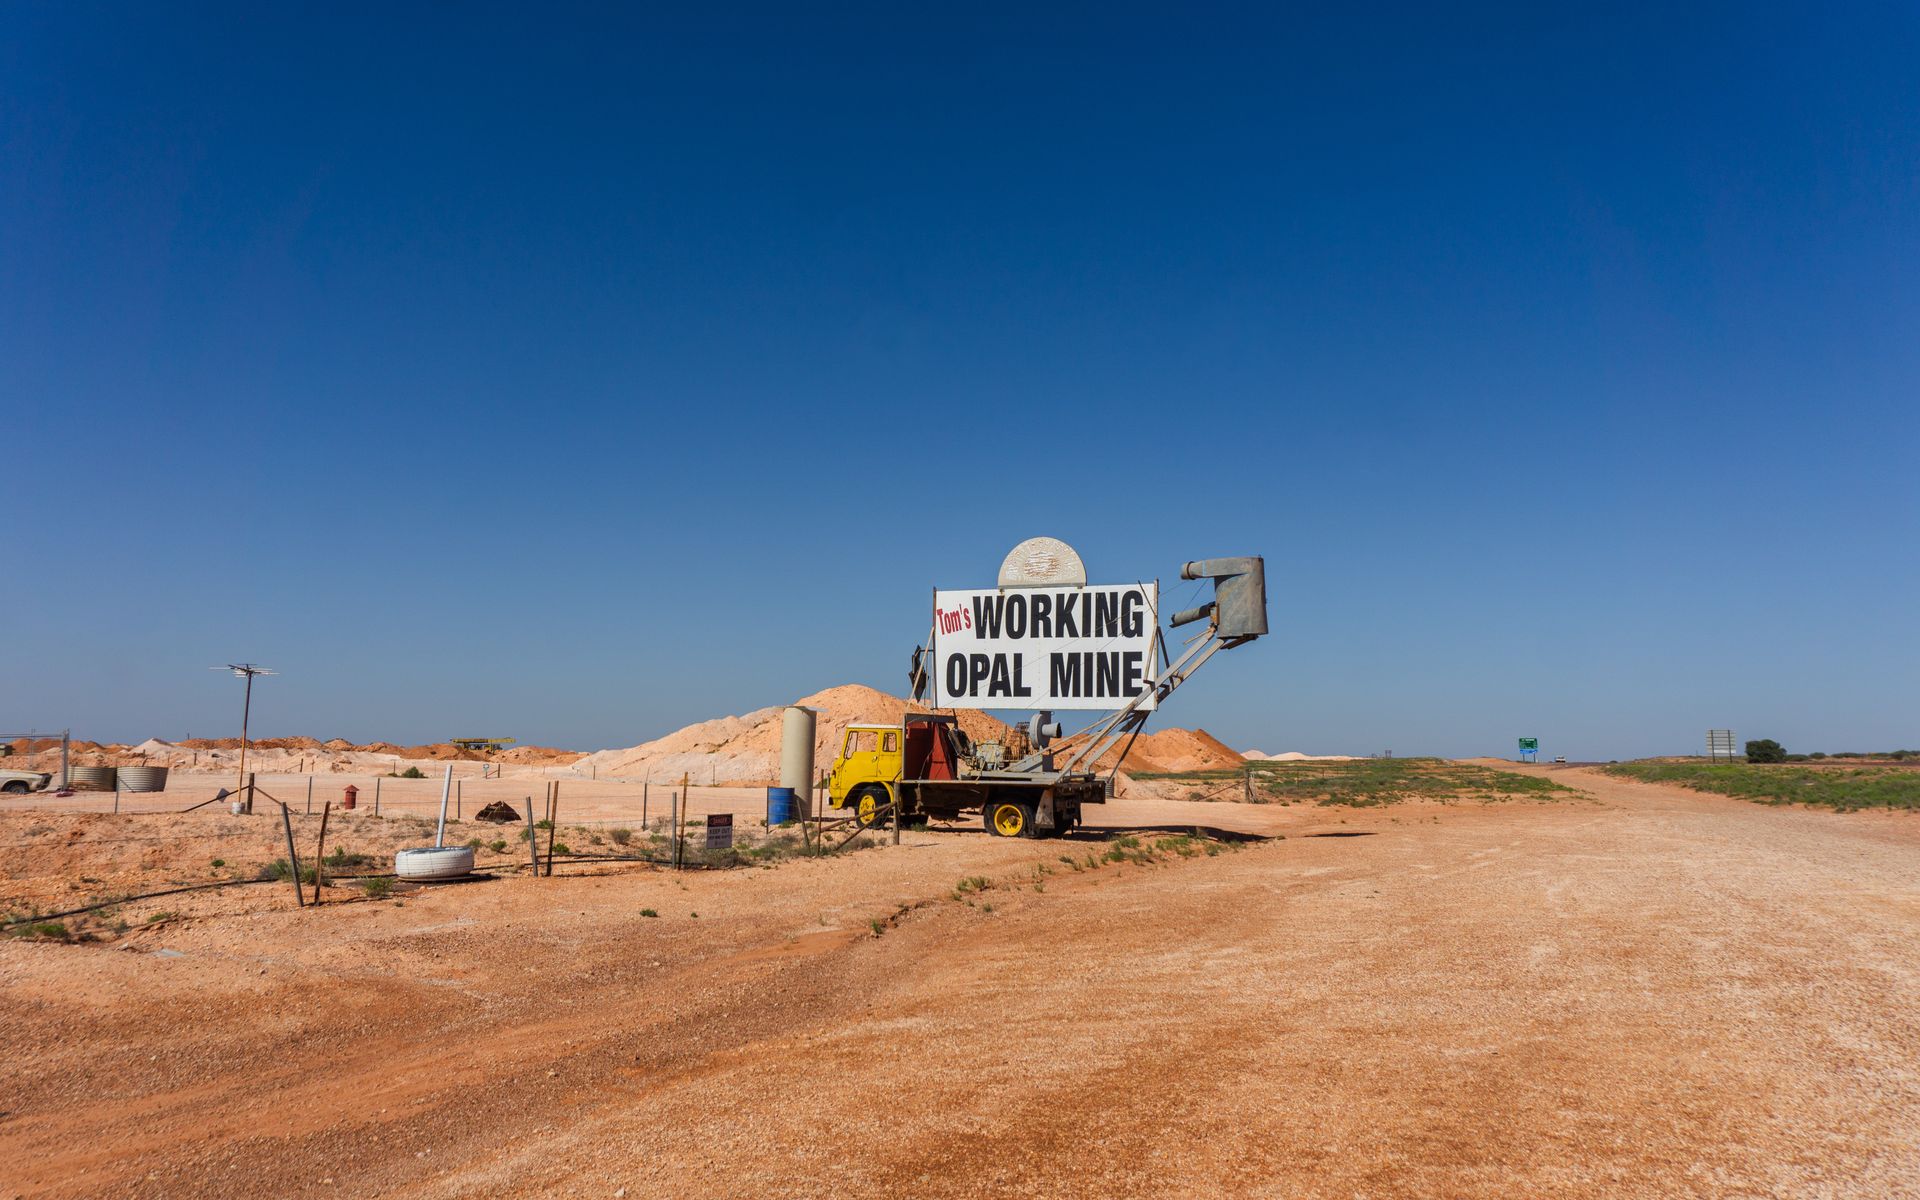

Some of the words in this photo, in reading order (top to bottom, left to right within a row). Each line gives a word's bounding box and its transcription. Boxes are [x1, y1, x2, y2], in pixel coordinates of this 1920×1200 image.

[938, 604, 971, 635] Tom's
[973, 591, 1144, 639] WORKING
[946, 653, 1031, 698] OPAL
[1050, 652, 1143, 698] MINE
